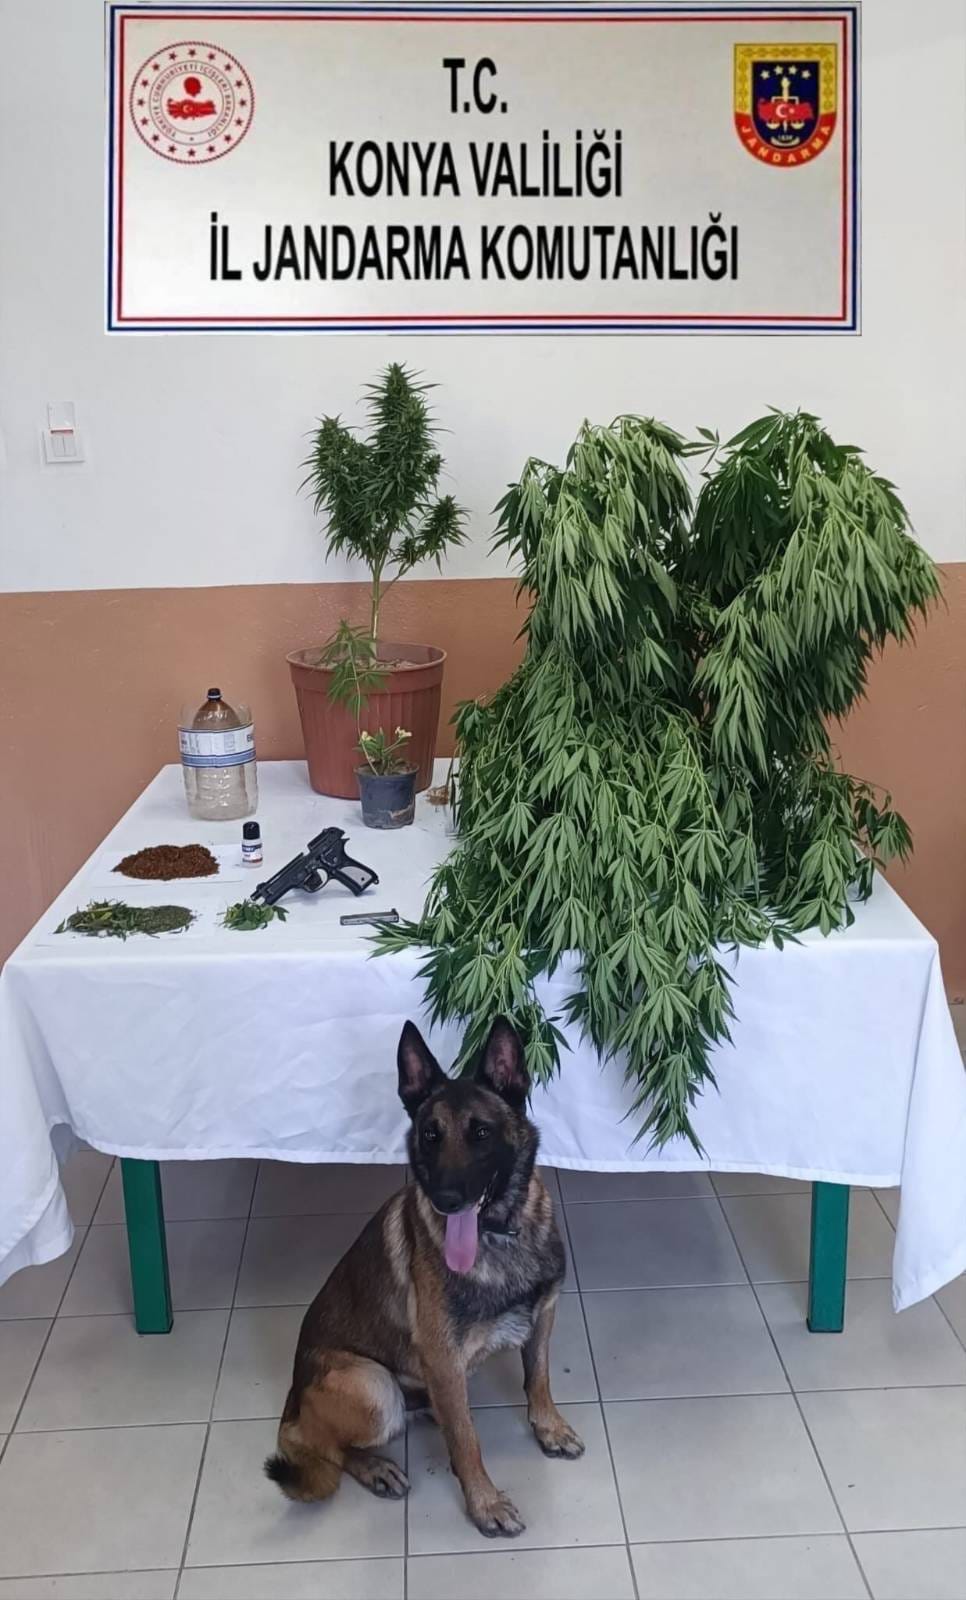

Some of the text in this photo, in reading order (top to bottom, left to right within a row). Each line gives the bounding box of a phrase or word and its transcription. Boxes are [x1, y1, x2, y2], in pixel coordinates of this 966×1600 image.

[442, 57, 508, 114] T.C.
[329, 129, 622, 197] KONYA VALİLİĞİ
[741, 125, 831, 163] JANDARMA
[210, 211, 738, 280] İL JANDARMA KOMUTANLIĞI
